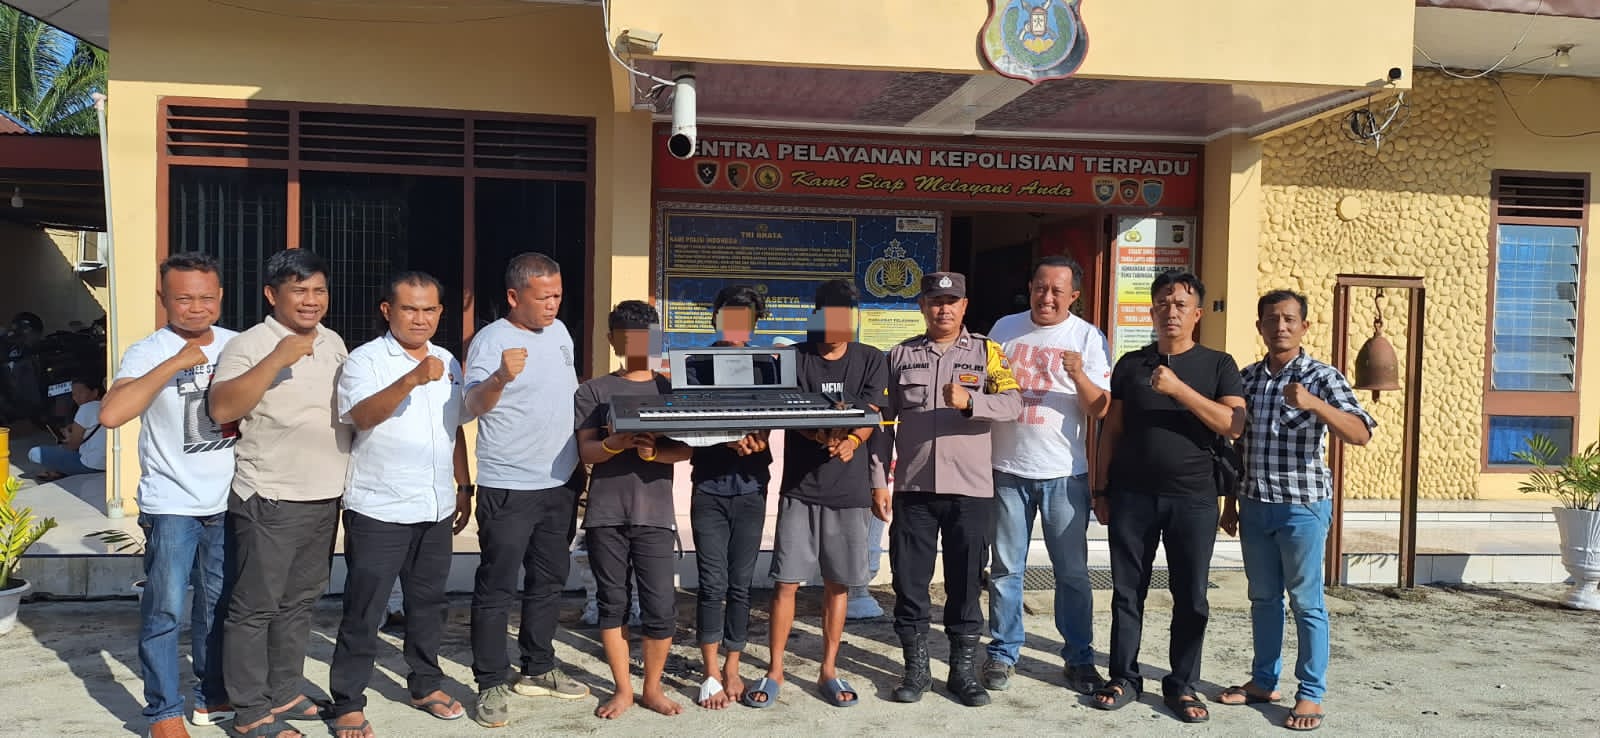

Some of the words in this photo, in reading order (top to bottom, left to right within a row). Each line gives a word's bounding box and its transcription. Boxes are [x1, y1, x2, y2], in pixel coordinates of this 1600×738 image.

[695, 140, 770, 159] NTRA
[777, 143, 922, 166] PELAYANAN
[930, 150, 1074, 171] KEPOLISIAN
[1082, 157, 1190, 176] TERPADU
[791, 171, 849, 188] Kami
[856, 173, 905, 193] Siap
[914, 175, 1012, 195] Melayani
[1017, 181, 1073, 196] Anda
[764, 295, 800, 304] ASETYA
[954, 363, 984, 372] POLRI
[1009, 343, 1065, 373] JUST
[1016, 367, 1053, 396] DO
